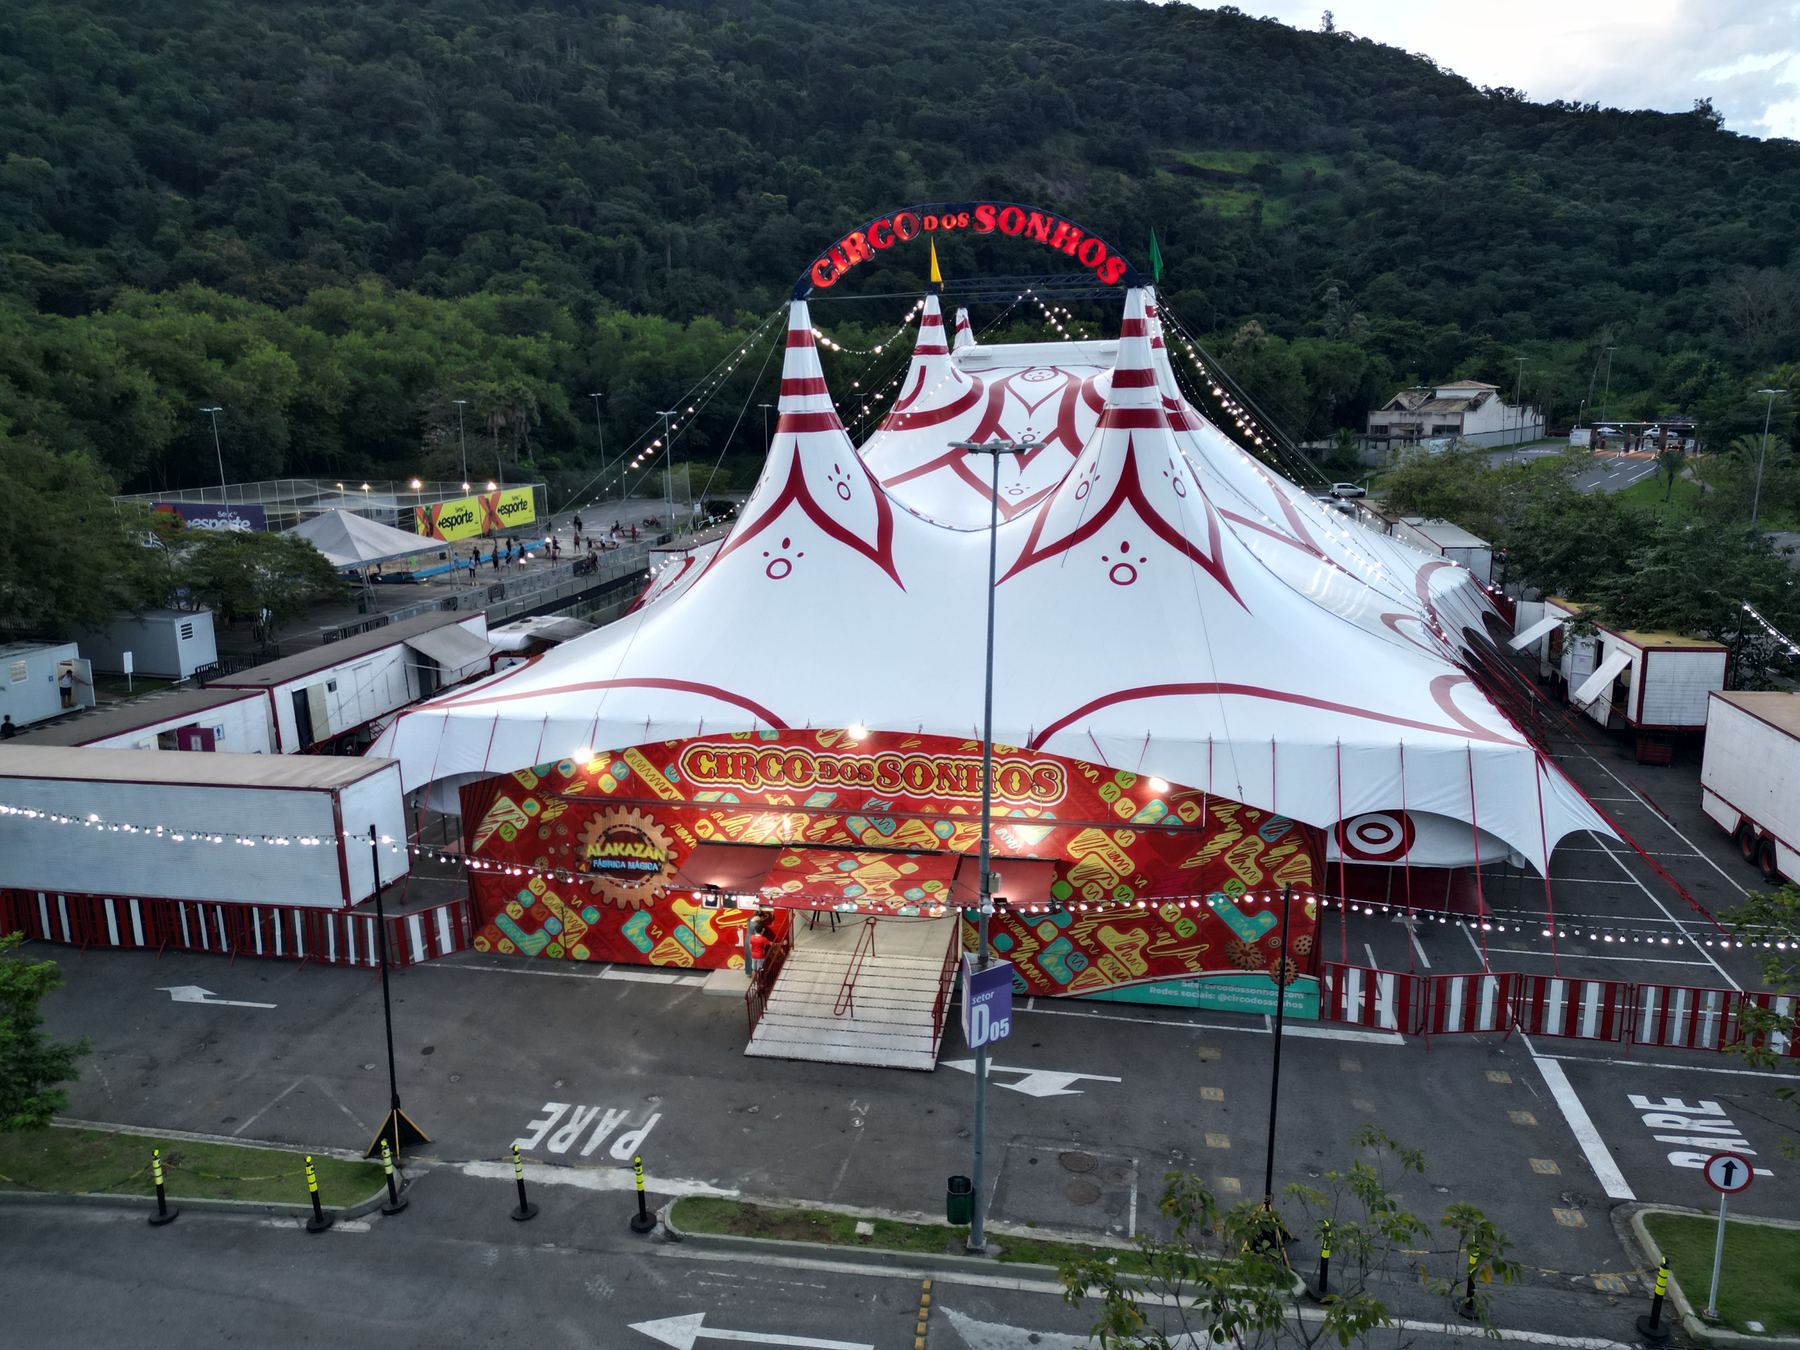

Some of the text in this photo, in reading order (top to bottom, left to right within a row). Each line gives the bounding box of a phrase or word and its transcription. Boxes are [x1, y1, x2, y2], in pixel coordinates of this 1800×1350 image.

[810, 204, 1127, 288] CIRCO DOS SONHOS
[687, 751, 1058, 797] CIRCO DOS SONHOS
[972, 991, 995, 1005] setor
[1150, 986, 1179, 996] Redes
[509, 1102, 663, 1161] PARE
